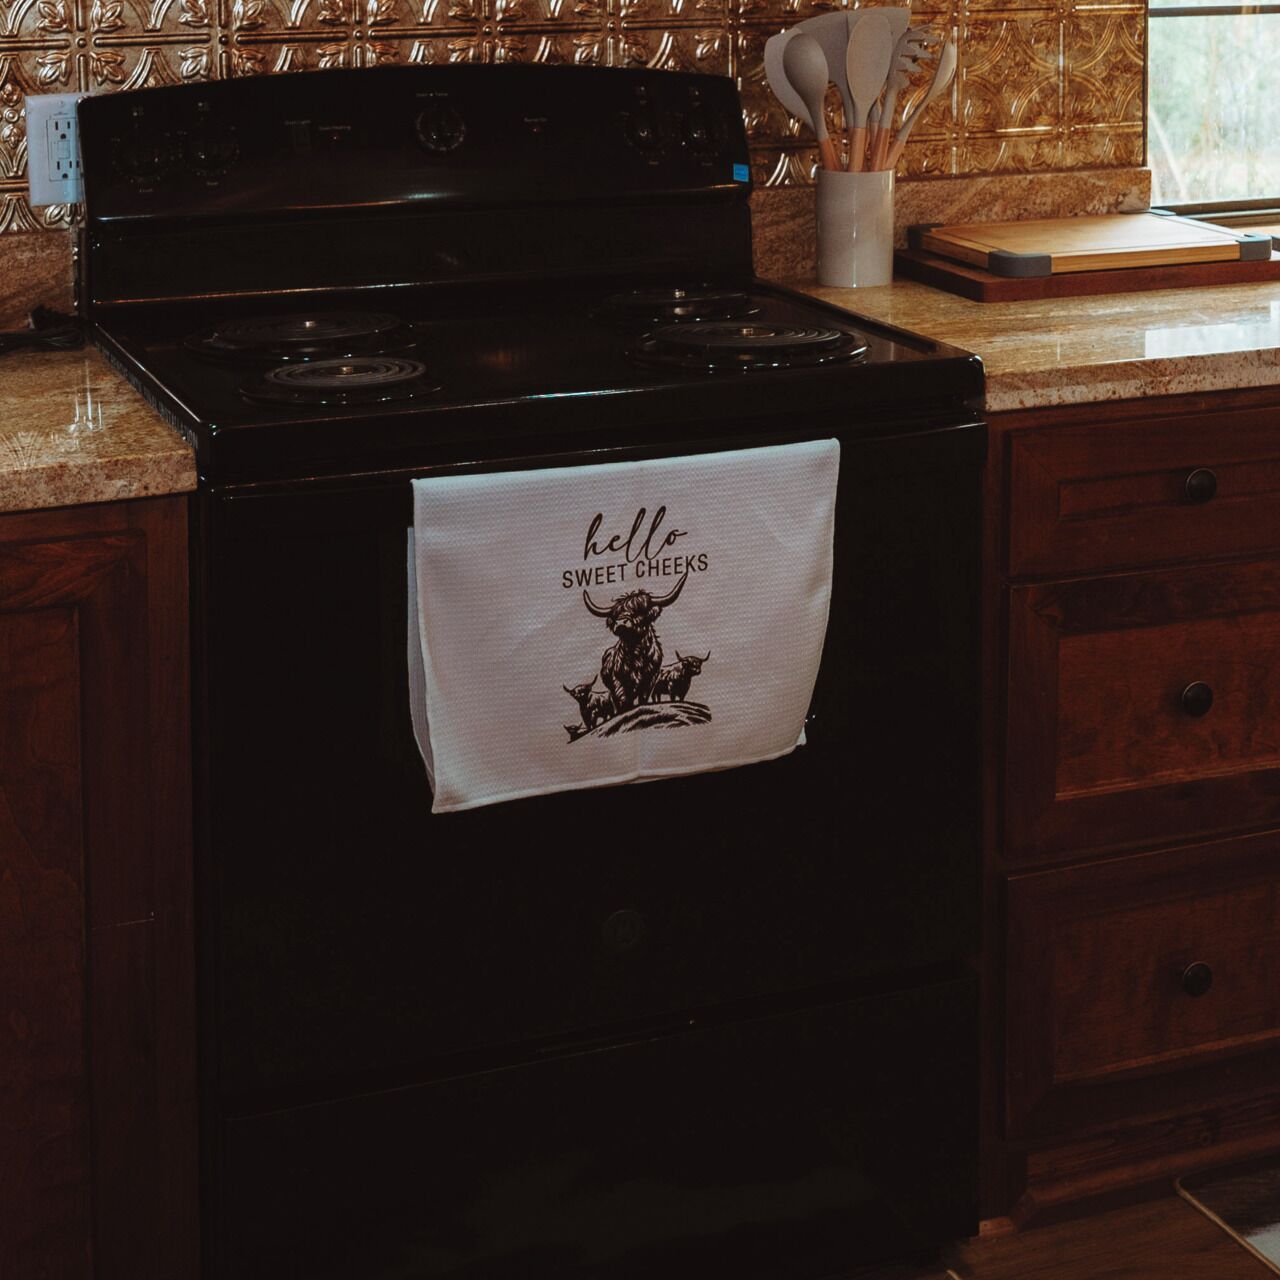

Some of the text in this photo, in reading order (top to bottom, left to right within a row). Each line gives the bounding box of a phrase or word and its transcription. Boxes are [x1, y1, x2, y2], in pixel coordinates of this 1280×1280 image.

[583, 505, 688, 563] hello
[562, 553, 709, 589] SWEET CHEEKS
